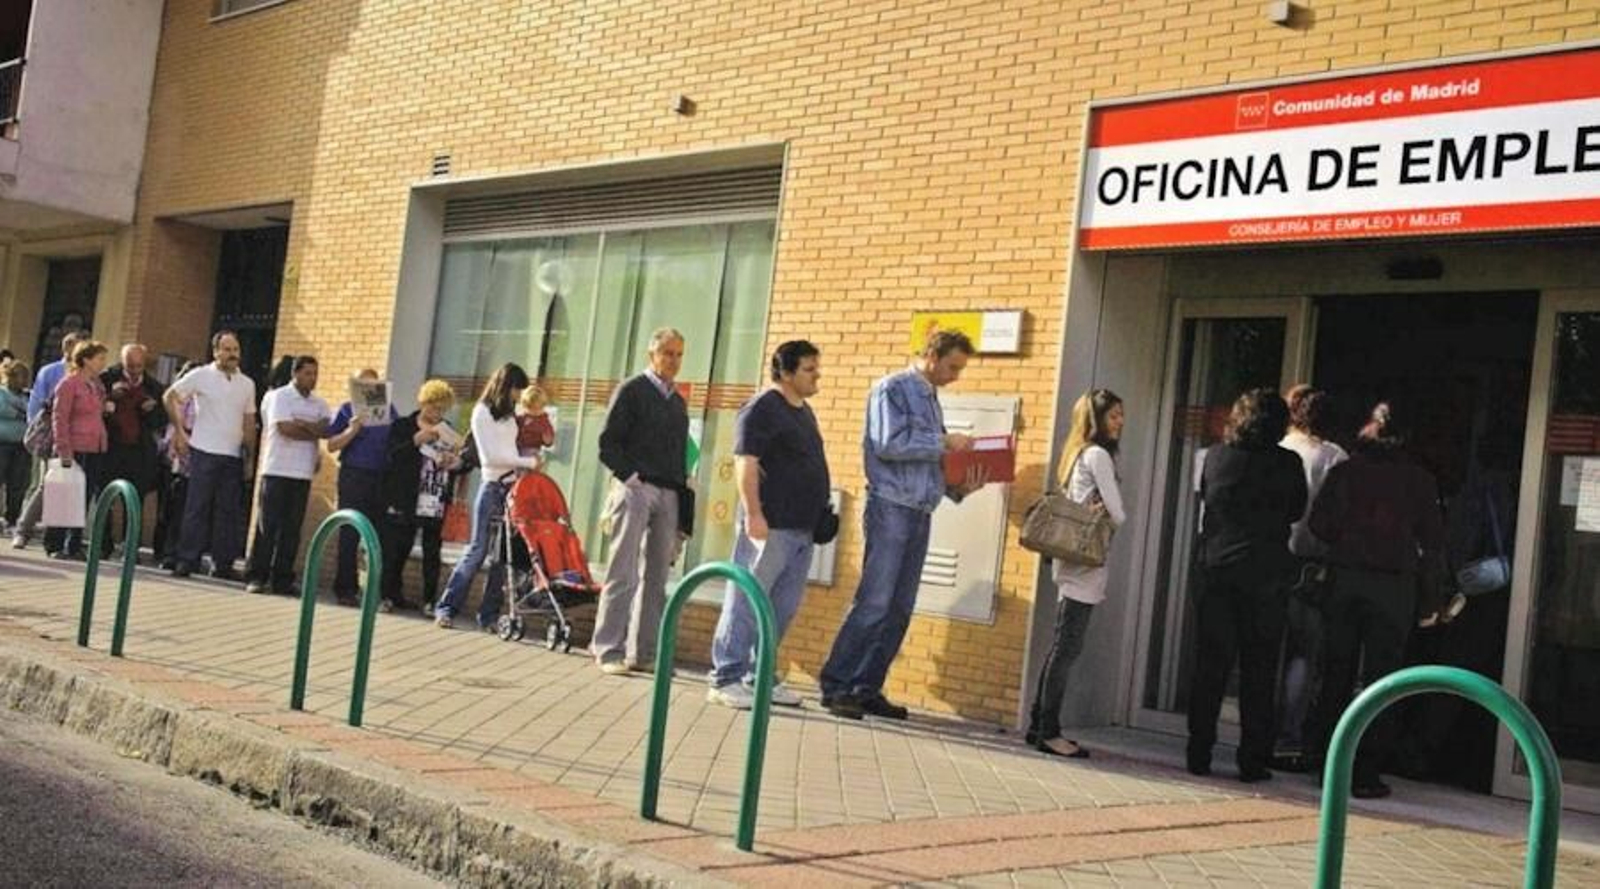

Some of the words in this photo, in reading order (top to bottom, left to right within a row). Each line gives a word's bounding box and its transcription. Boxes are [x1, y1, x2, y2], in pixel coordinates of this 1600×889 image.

[1272, 92, 1375, 116] Comunidad
[1381, 89, 1404, 105] de
[1410, 79, 1481, 102] Madrid
[1096, 153, 1290, 207] OFICINA
[1307, 144, 1381, 192] DE
[1399, 125, 1600, 185] EMPLE
[1228, 220, 1310, 237] CONSEJERÍA
[1312, 218, 1332, 231] DE
[1334, 215, 1394, 231] EMPLEO
[1397, 215, 1406, 226] Y
[1408, 211, 1463, 228] MUJER
